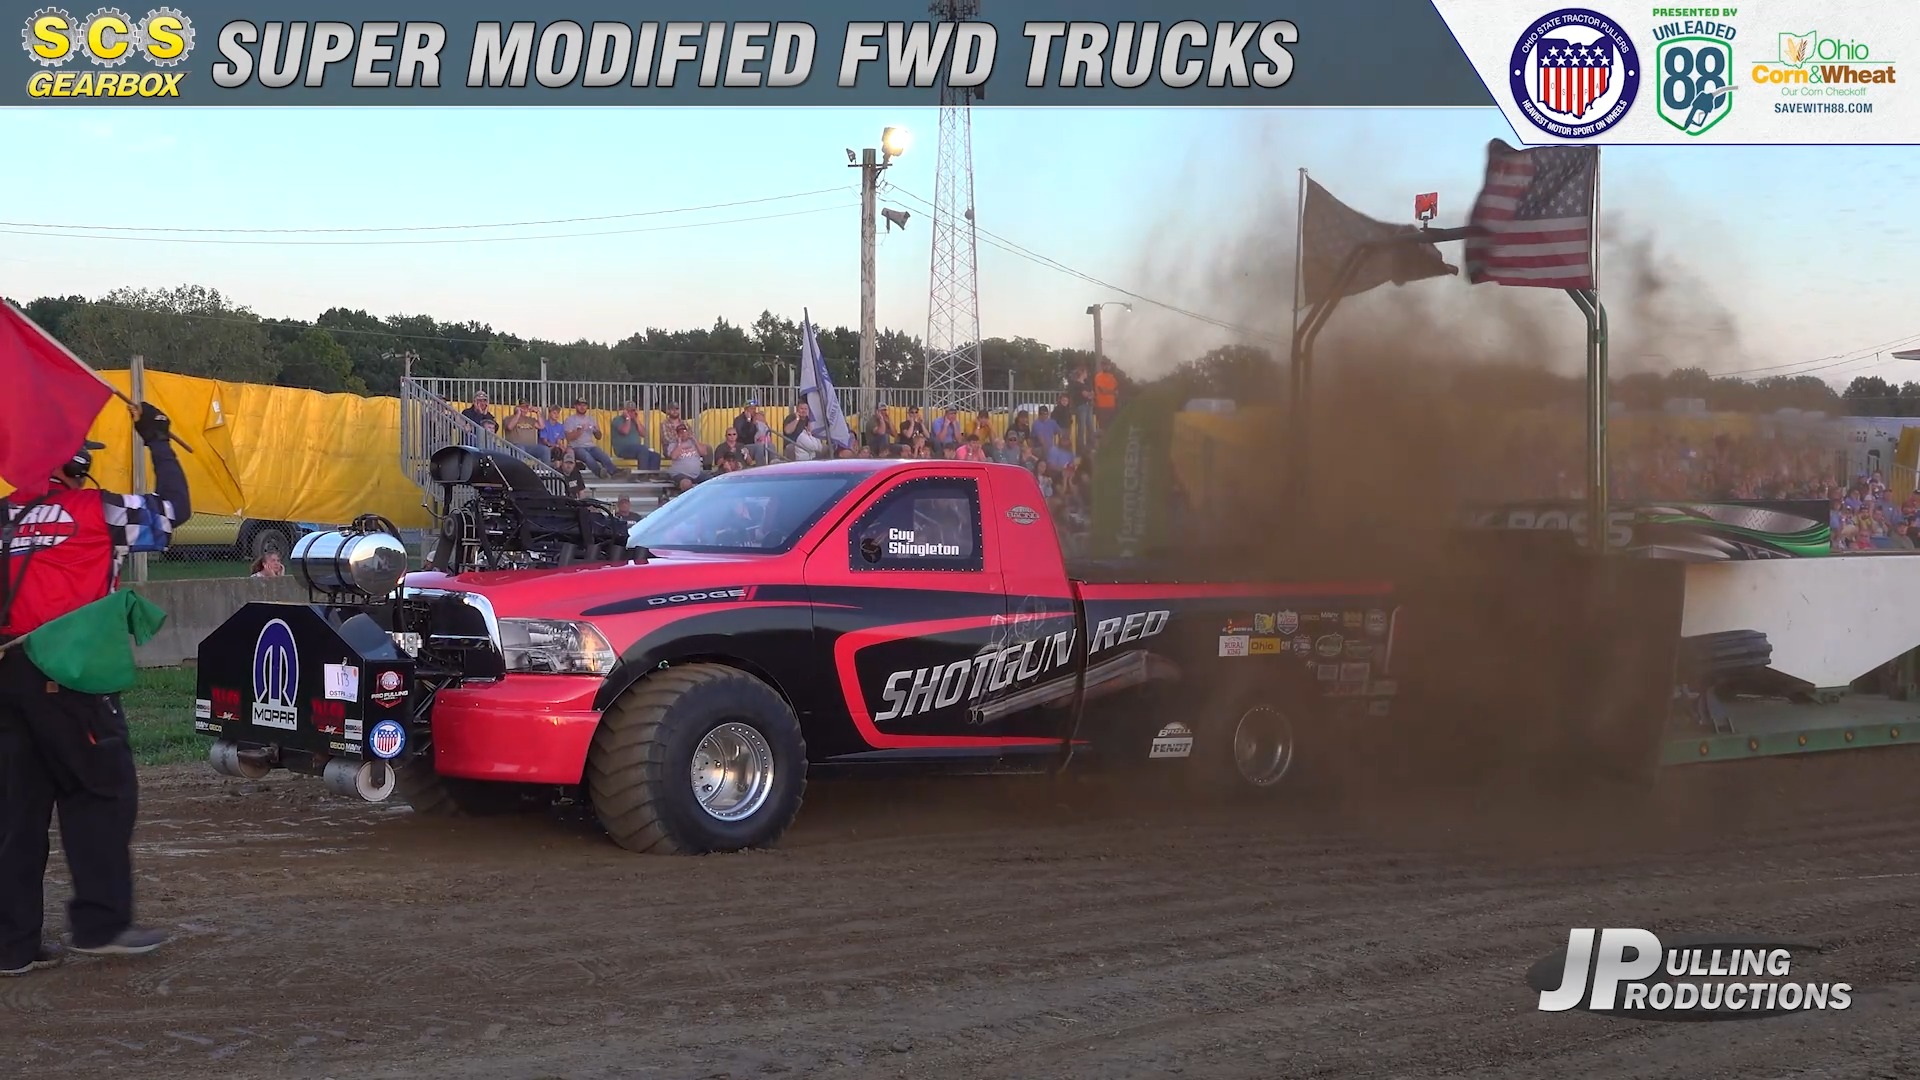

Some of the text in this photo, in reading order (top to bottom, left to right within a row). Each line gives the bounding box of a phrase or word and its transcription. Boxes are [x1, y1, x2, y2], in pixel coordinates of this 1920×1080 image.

[889, 528, 915, 543] Guy
[888, 541, 960, 557] Shingleton
[647, 589, 747, 605] DODGE
[874, 610, 1170, 722] SHOTGUN RED
[254, 707, 295, 725] MOPAR
